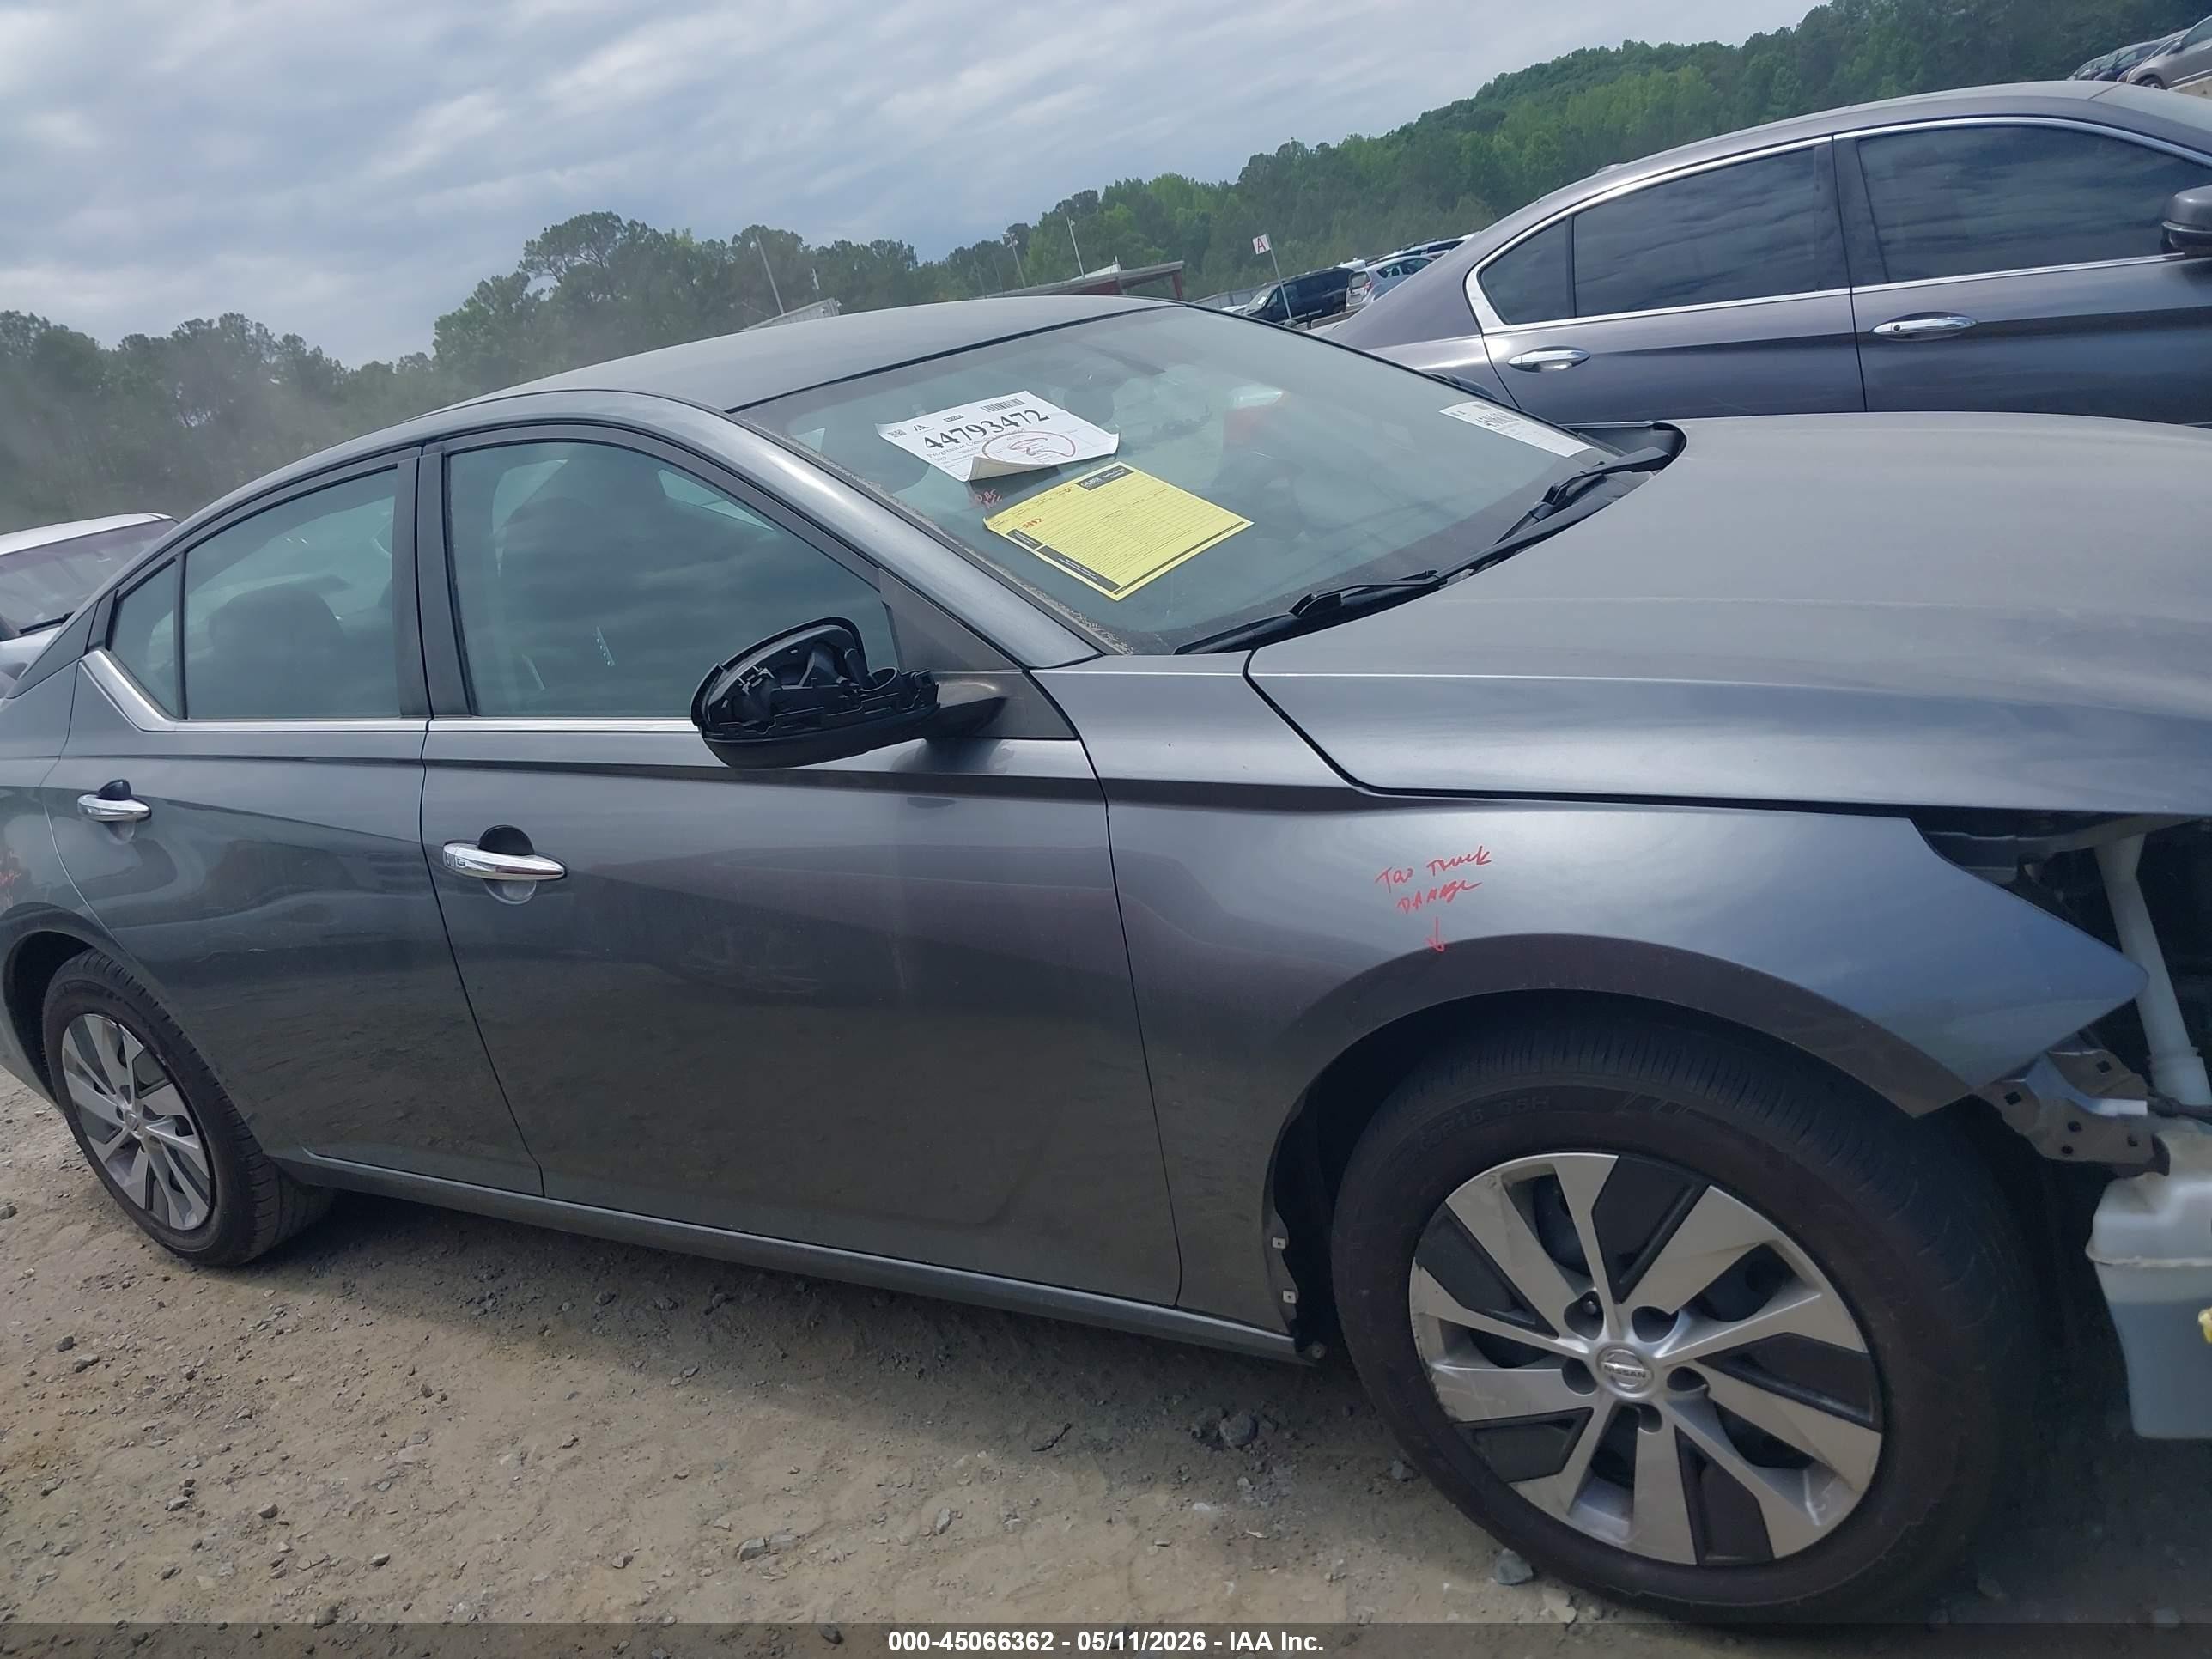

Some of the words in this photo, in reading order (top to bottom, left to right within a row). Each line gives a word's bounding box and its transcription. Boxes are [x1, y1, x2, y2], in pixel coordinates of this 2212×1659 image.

[1257, 237, 1267, 252] A
[924, 409, 1051, 448] 44793472
[1604, 1365, 1646, 1378] NISSAN
